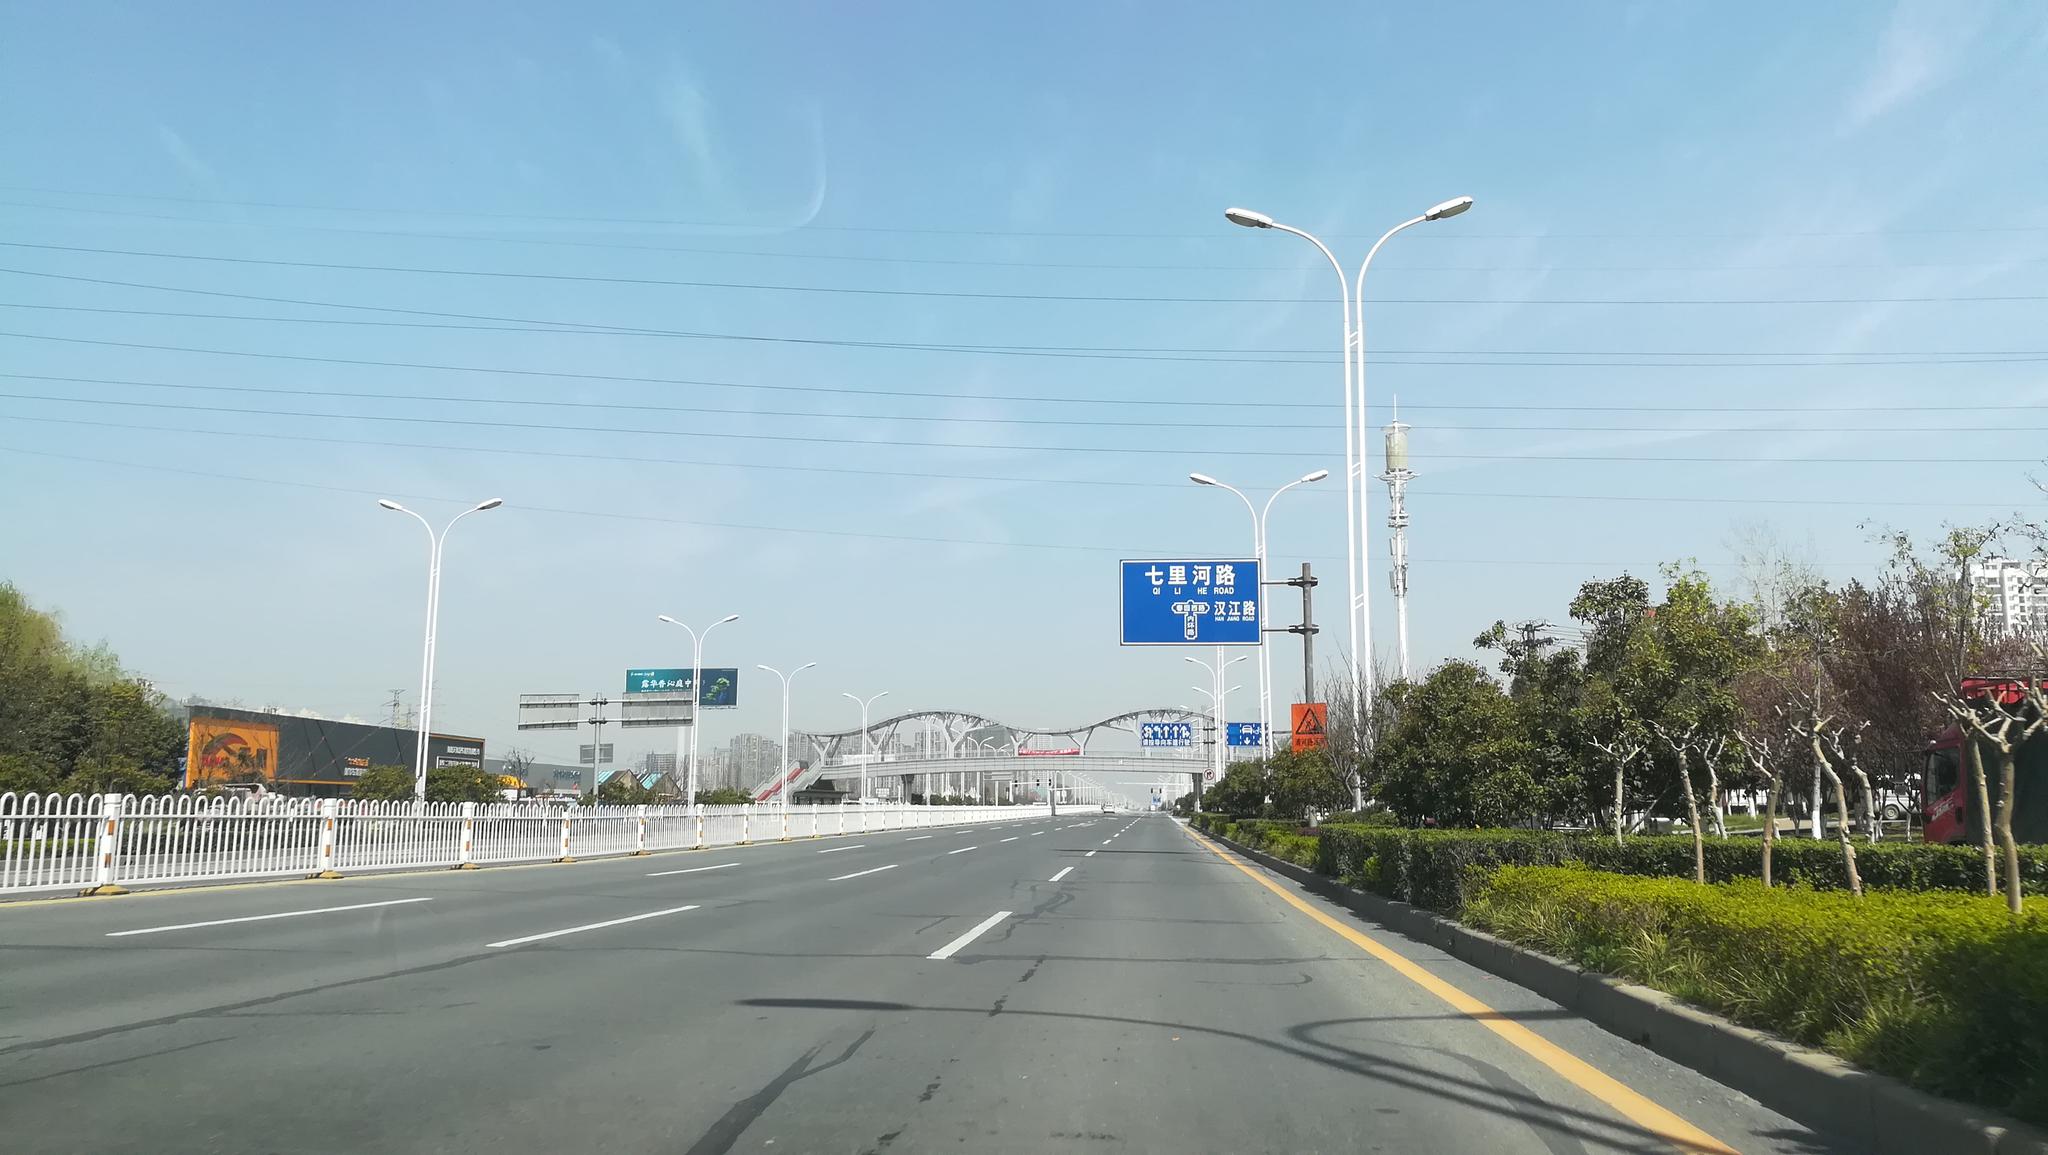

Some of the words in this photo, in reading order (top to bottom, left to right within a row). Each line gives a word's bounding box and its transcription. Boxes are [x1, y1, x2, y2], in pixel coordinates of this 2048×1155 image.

[1144, 564, 1235, 586] 七里河路
[1152, 587, 1161, 595] QI
[1174, 587, 1181, 595] LI
[1197, 587, 1207, 595] HE
[1213, 587, 1235, 595] ROAD
[1214, 600, 1256, 616] 汉江路
